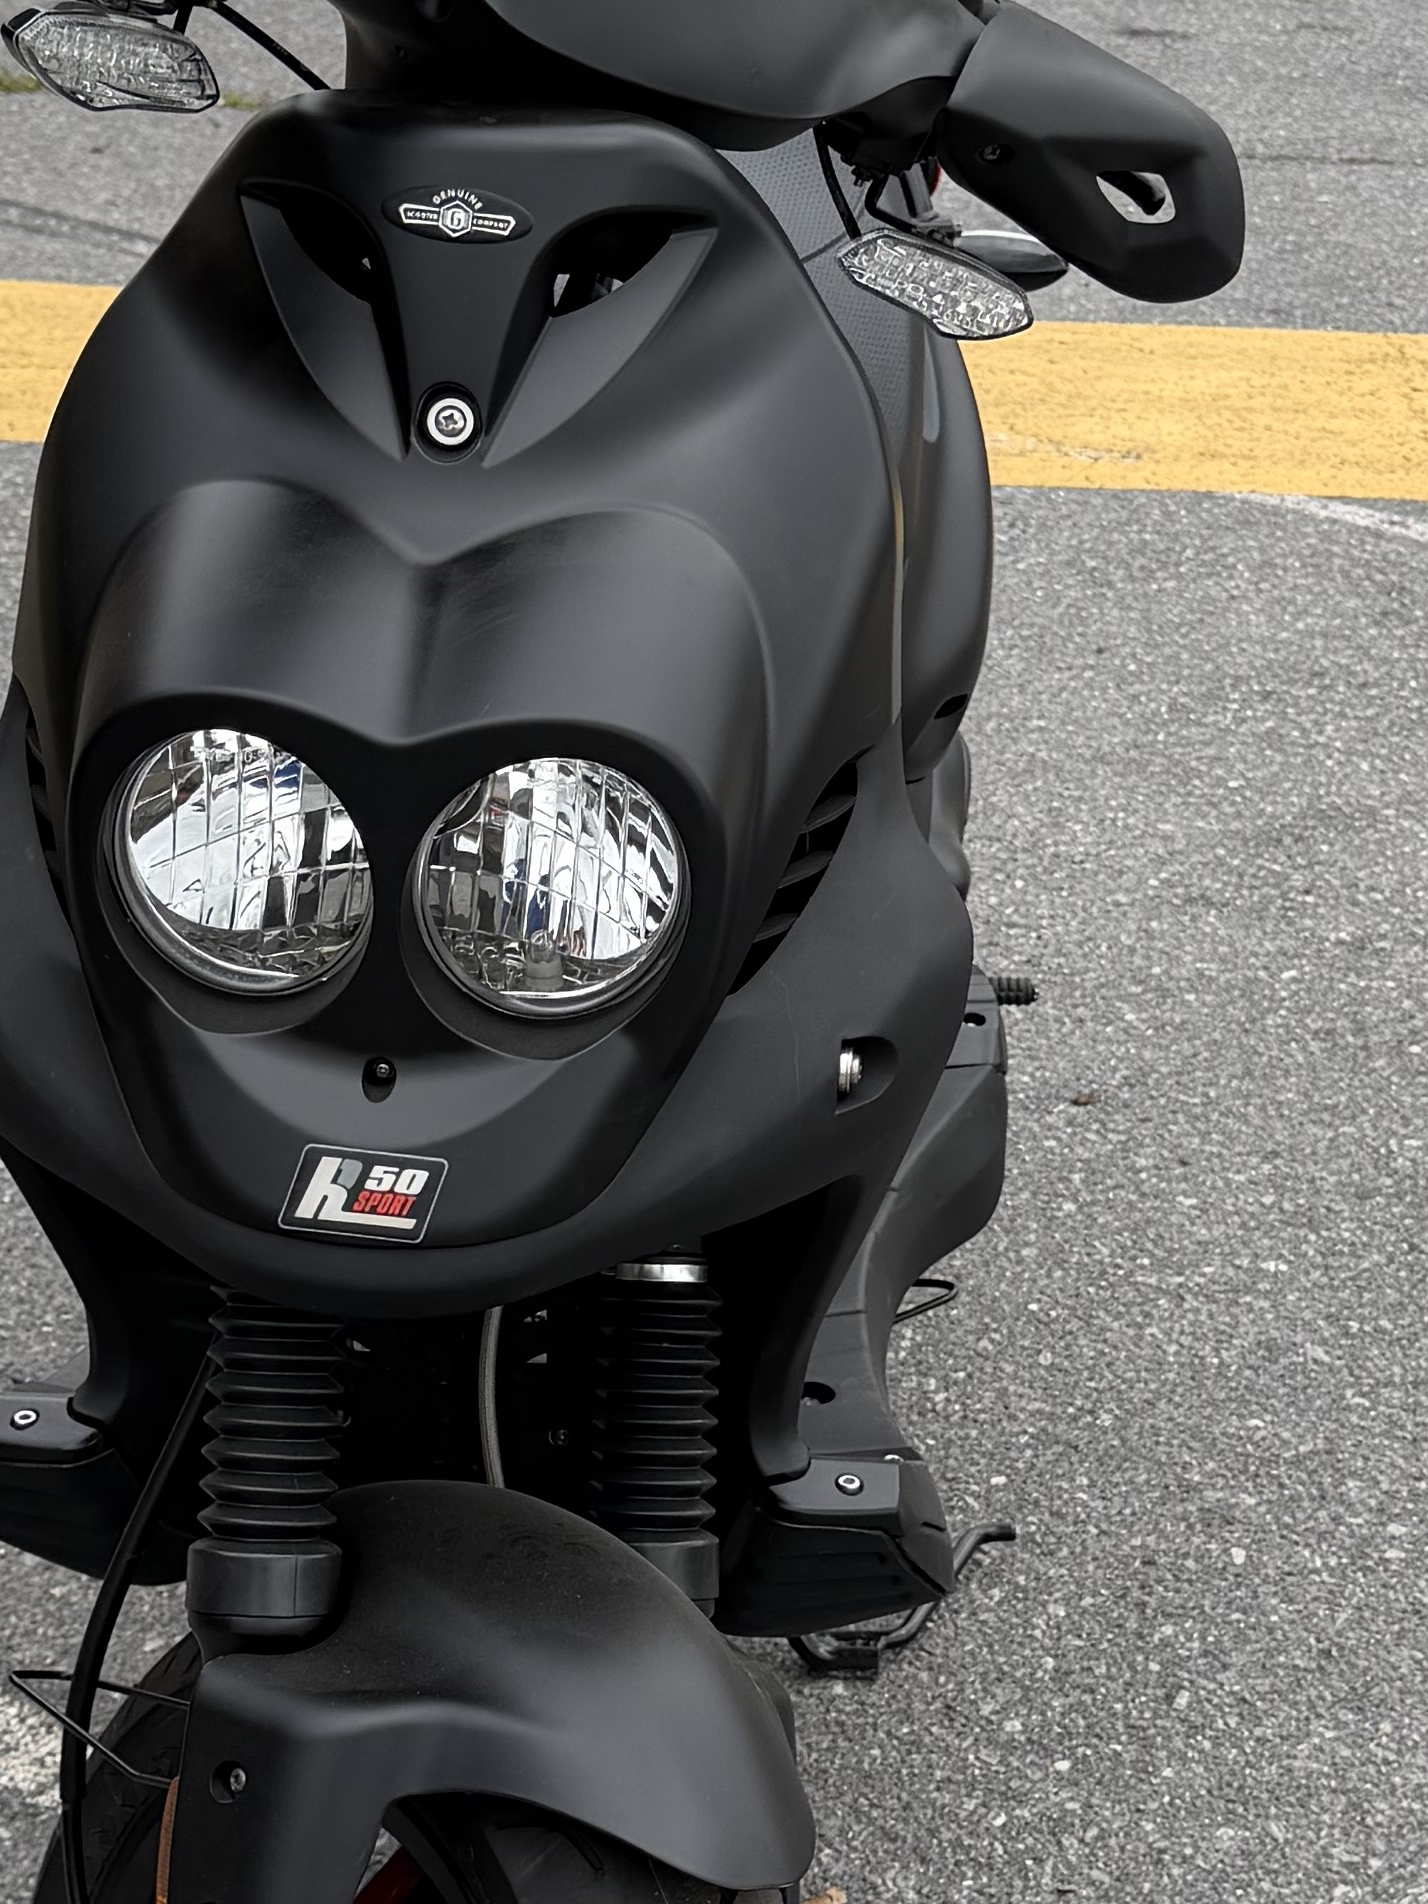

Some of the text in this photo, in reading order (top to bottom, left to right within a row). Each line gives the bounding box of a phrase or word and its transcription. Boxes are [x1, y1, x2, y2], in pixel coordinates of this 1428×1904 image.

[432, 189, 483, 210] GENUINE
[364, 1165, 430, 1196] 50
[352, 1190, 417, 1217] SPORT
